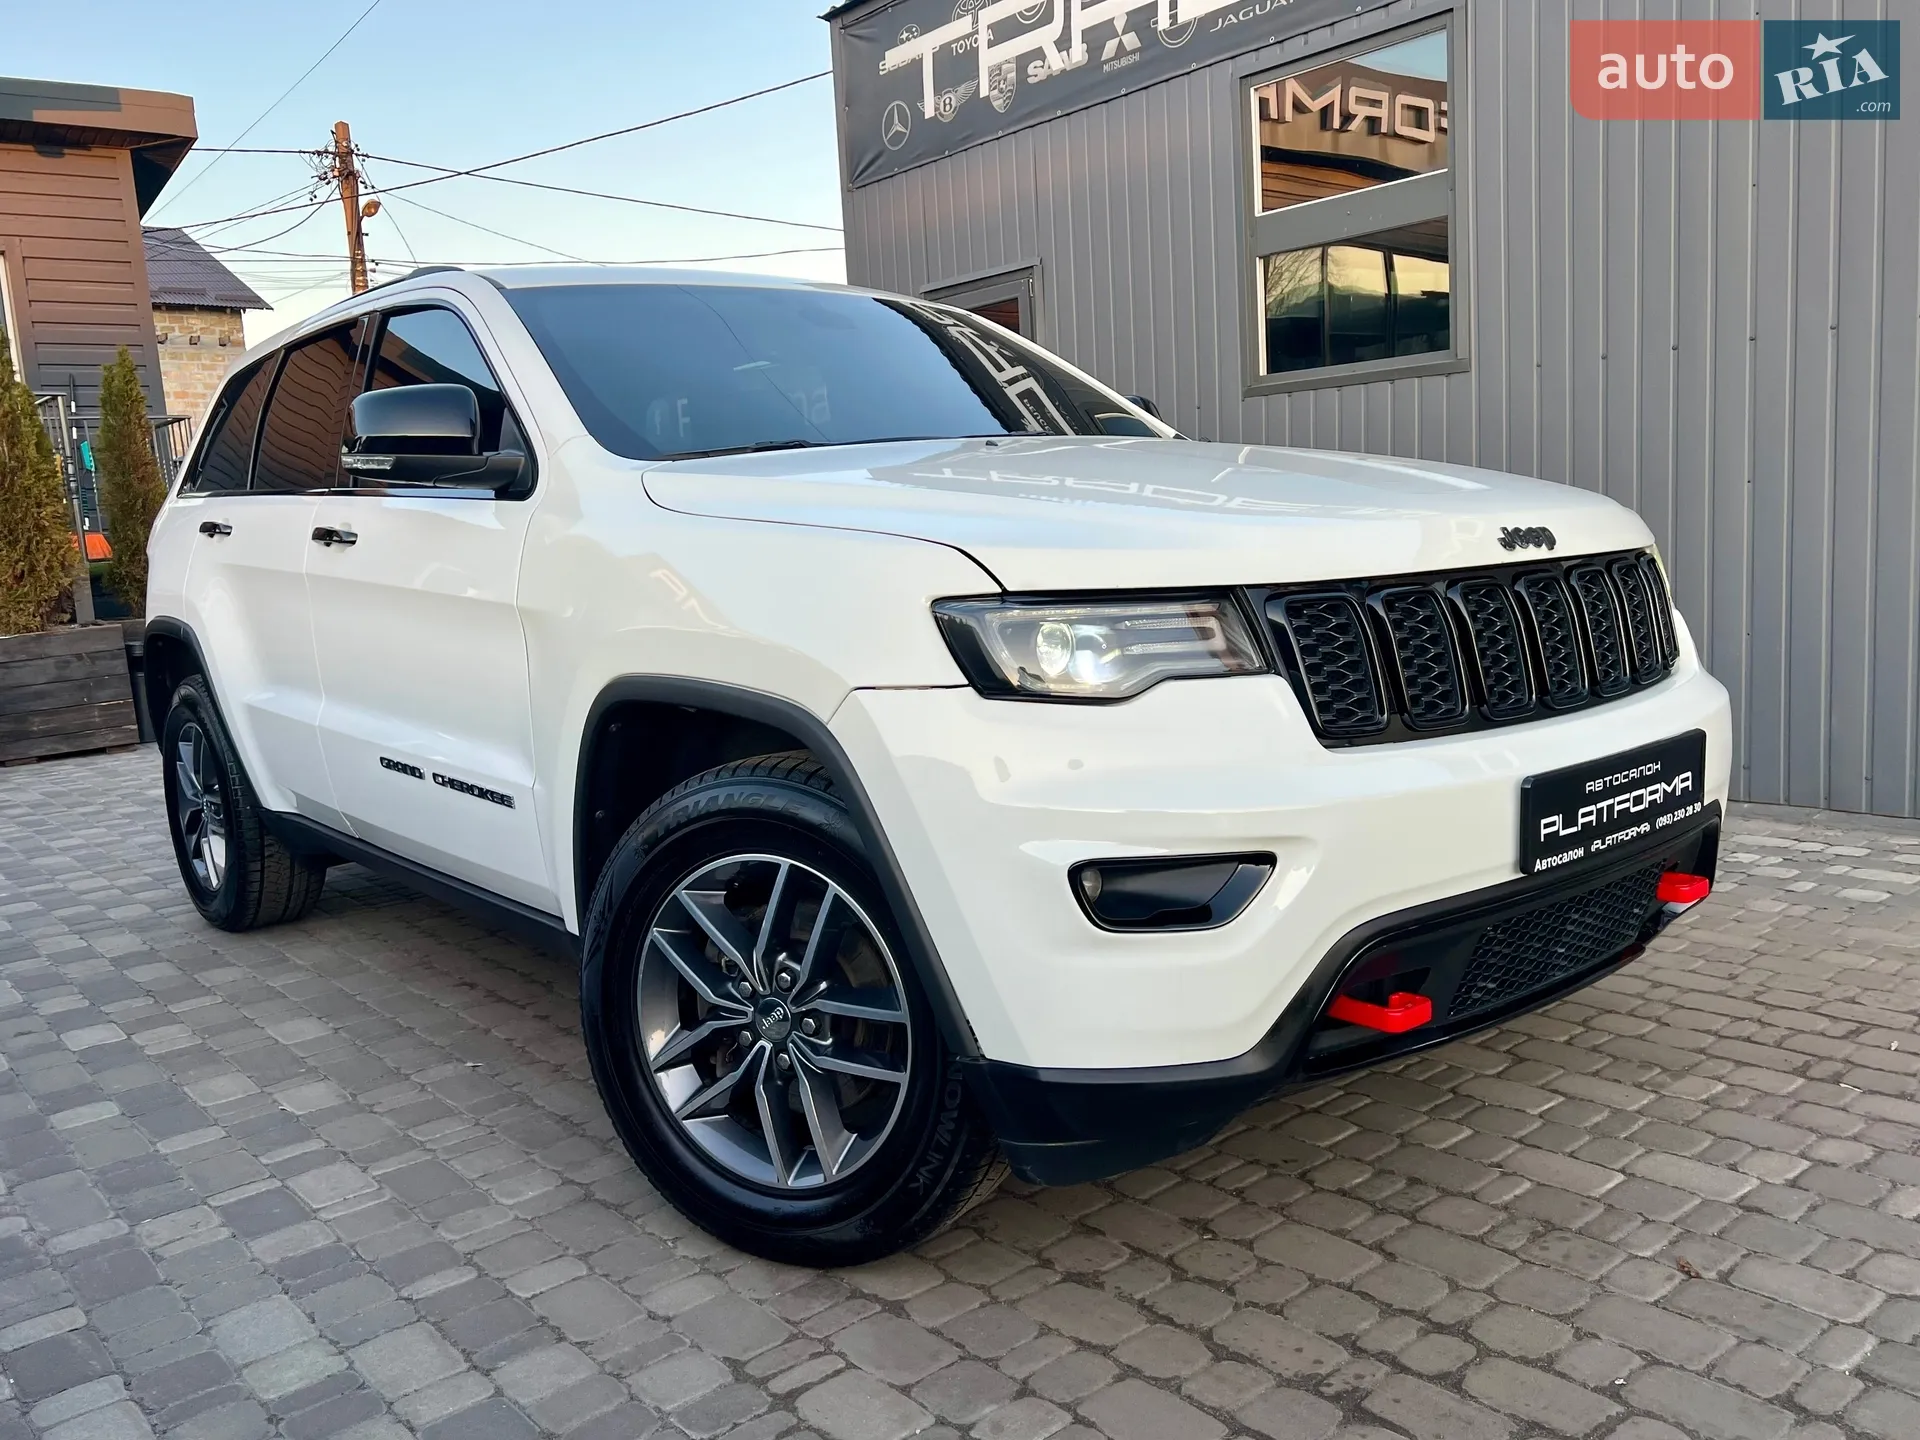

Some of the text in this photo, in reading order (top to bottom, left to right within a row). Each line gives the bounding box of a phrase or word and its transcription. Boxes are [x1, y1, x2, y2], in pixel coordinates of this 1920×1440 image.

[1209, 0, 1296, 32] JAGUA
[951, 29, 994, 56] TOYOA
[1103, 52, 1140, 73] MITSUBISHI
[1497, 526, 1557, 551] Jeep
[380, 756, 517, 810] GRAND CHEROKEE
[1585, 761, 1661, 794] АВТОСАЛОН
[655, 791, 810, 838] TRIANGLE
[1540, 771, 1692, 842] PLATFORMA
[1534, 846, 1585, 873] Автосалон
[1655, 813, 1673, 829] (093)
[1673, 808, 1686, 821] 230
[762, 1006, 784, 1030] Jeep
